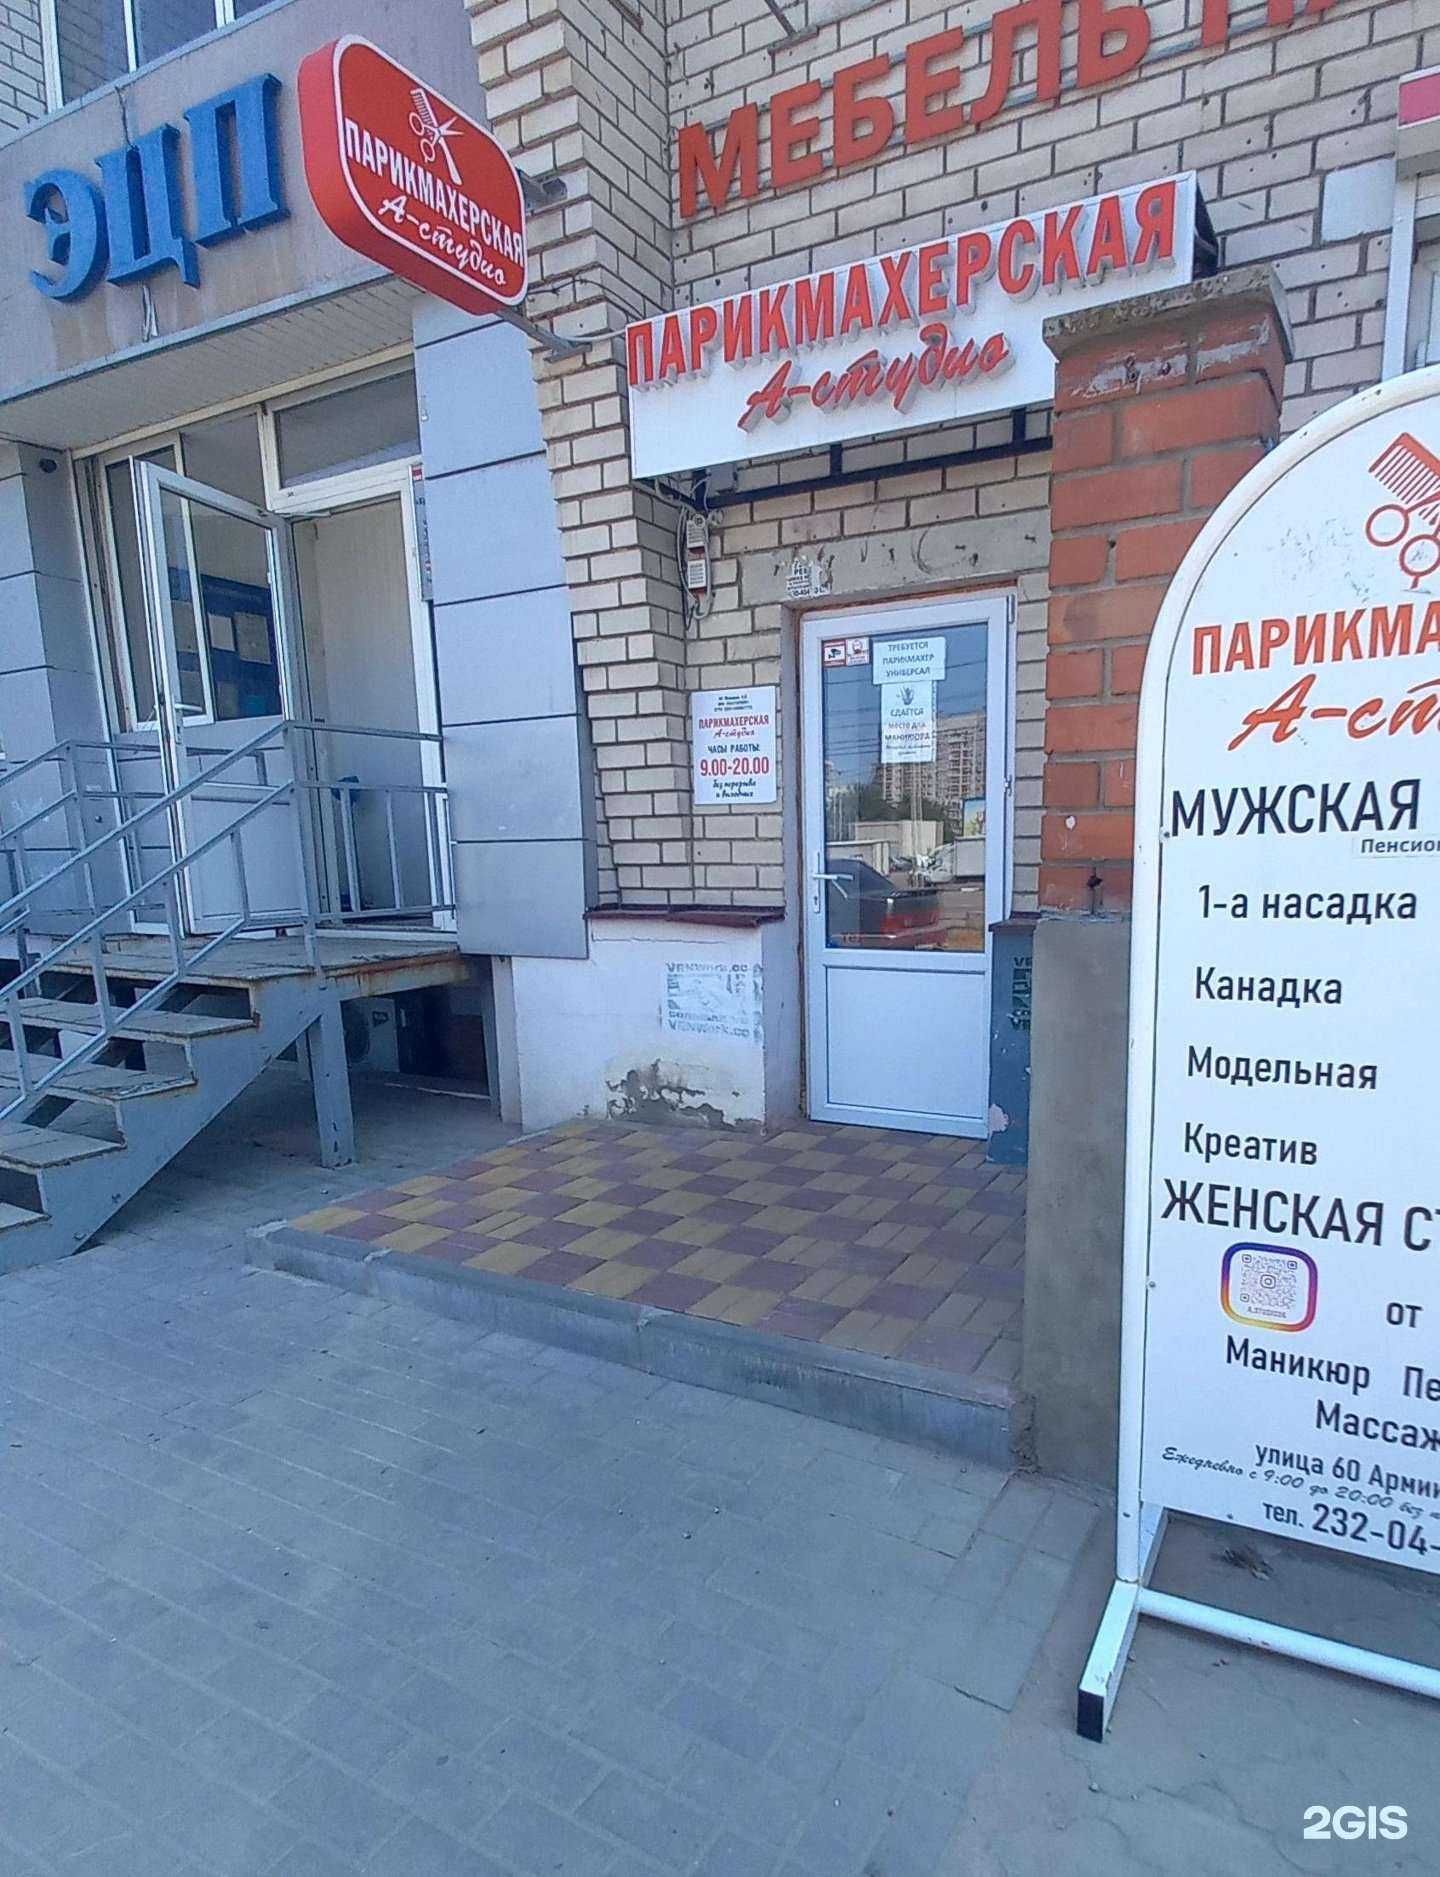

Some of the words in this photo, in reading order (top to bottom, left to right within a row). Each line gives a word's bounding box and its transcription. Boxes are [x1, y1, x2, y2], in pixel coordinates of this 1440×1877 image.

[678, 0, 1151, 219] МЕБЕЛЬ
[25, 73, 290, 301] ЭЦП
[343, 118, 524, 267] ПАРИКМАХЕРСКАЯ
[627, 181, 1177, 386] ПАРИКМАХЕРСКАЯ
[887, 641, 929, 652] ТРЕБУЕТСЯ
[1192, 600, 1440, 675] ПАРИКМА
[882, 654, 934, 665] ПАРИКМАХЕР
[885, 666, 931, 677] УНИВЕРСАЛ
[698, 714, 769, 729] ПАРИКМАХЕРСКАЯ
[700, 756, 770, 777] 9.00-20.00
[707, 744, 727, 754] ЧАСЫ
[1171, 779, 1422, 838] МУЖСКАЯ
[1198, 884, 1249, 919] 1-а
[1261, 892, 1417, 925] насадка
[1195, 966, 1343, 1008] Канадка
[1188, 1045, 1378, 1090] Модельная
[1184, 1122, 1318, 1165] Креатив
[1161, 1178, 1384, 1247] ЖЕНСКАЯ
[1386, 1301, 1422, 1328] от
[1226, 1335, 1370, 1395] Маникюр
[1315, 1400, 1440, 1453] Массаж
[1162, 1446, 1244, 1477] Ежедневно
[1249, 1471, 1257, 1480] с
[1263, 1469, 1305, 1489] 9:00
[1309, 1484, 1328, 1497] до
[1333, 1485, 1395, 1509] 20:00
[1256, 1445, 1323, 1476] улица
[1332, 1457, 1360, 1482] 60
[1262, 1502, 1305, 1528] тел.
